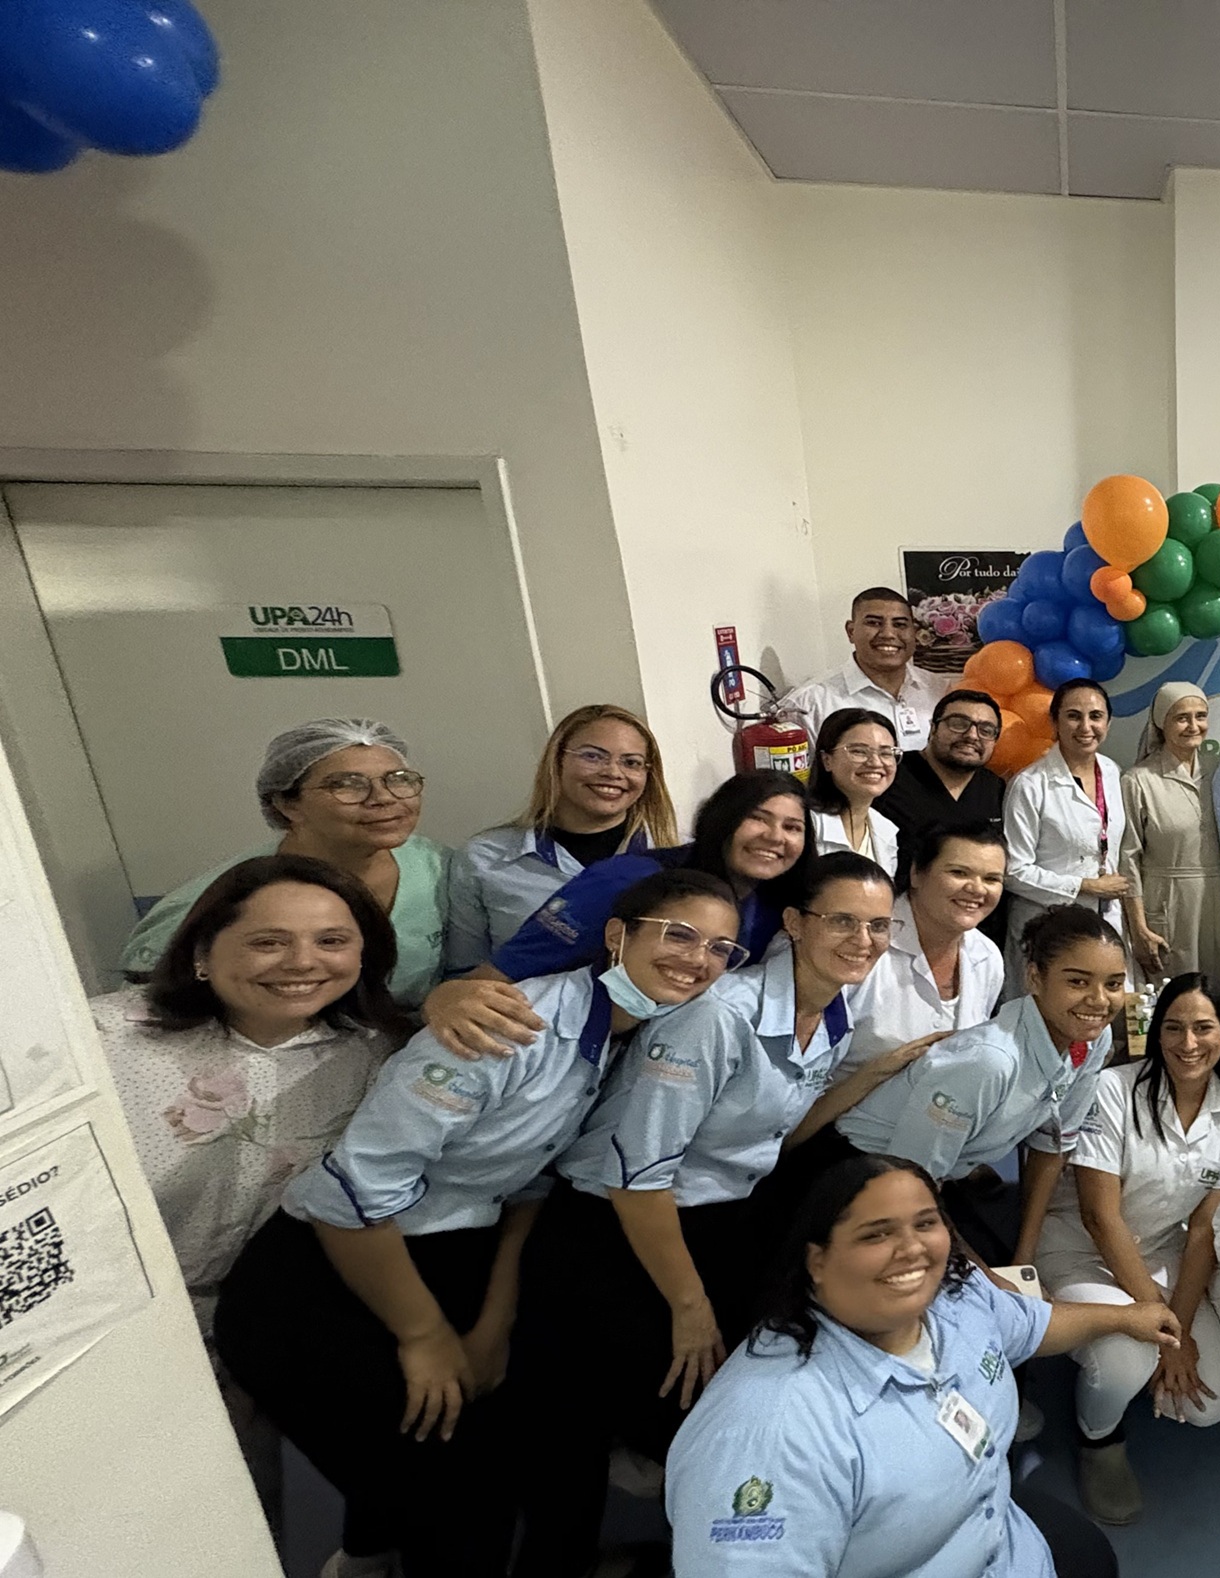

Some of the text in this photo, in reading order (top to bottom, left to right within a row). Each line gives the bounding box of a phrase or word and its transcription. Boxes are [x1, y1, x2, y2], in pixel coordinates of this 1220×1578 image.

[938, 556, 980, 581] Por
[974, 565, 1000, 577] tudo
[248, 606, 354, 626] UPA24h
[276, 648, 350, 671] DML
